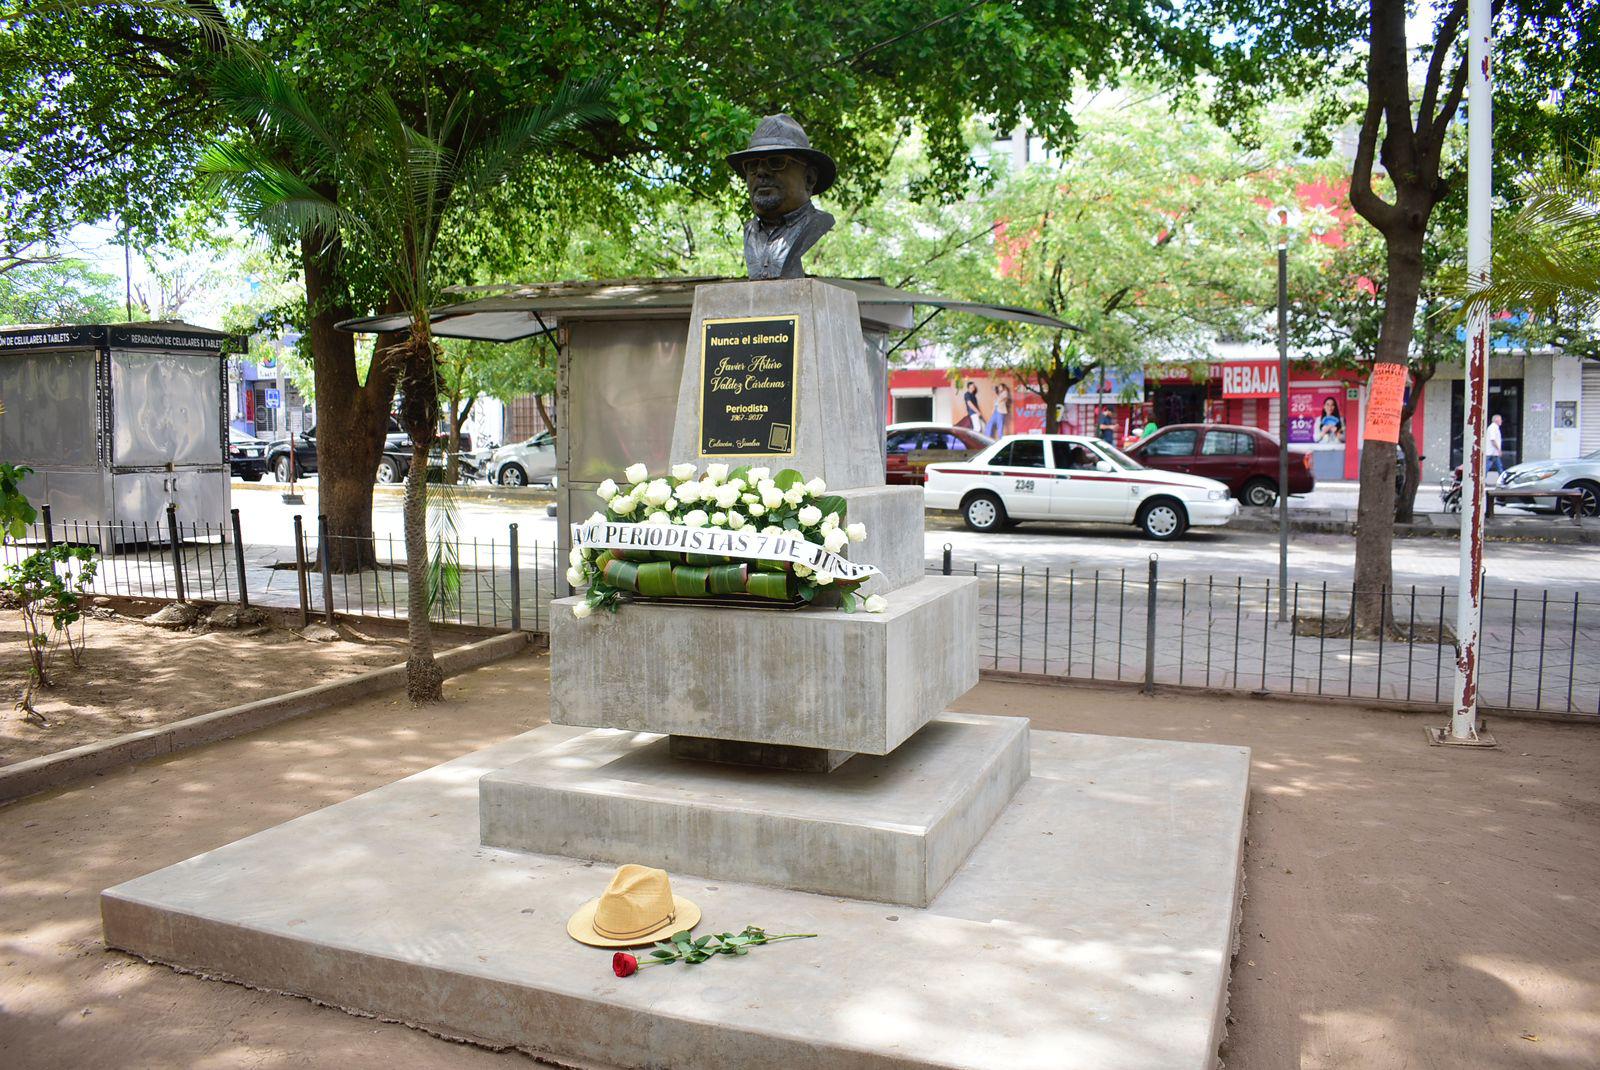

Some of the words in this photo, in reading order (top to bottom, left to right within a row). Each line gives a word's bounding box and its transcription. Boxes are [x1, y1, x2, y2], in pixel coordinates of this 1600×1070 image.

[7, 337, 14, 346] DE
[14, 335, 42, 346] CELULARES
[43, 334, 47, 343] &
[47, 333, 70, 344] TABLETS
[131, 333, 164, 345] REPARACIÓN
[164, 337, 172, 345] DE
[172, 337, 200, 347] CELULARES
[711, 337, 739, 346] Nunca
[742, 335, 750, 345] el
[753, 333, 788, 345] silencio
[714, 356, 744, 376] Javier
[711, 376, 743, 394] Valdez
[745, 375, 785, 390] Cárdenas
[1223, 366, 1280, 394] REBAJA
[726, 404, 768, 413] Periodista
[1291, 419, 1312, 429] 10%
[1015, 480, 1035, 490] 2349
[605, 525, 749, 552] PERIODISTAS
[757, 536, 768, 555] 7
[774, 538, 804, 559] DE
